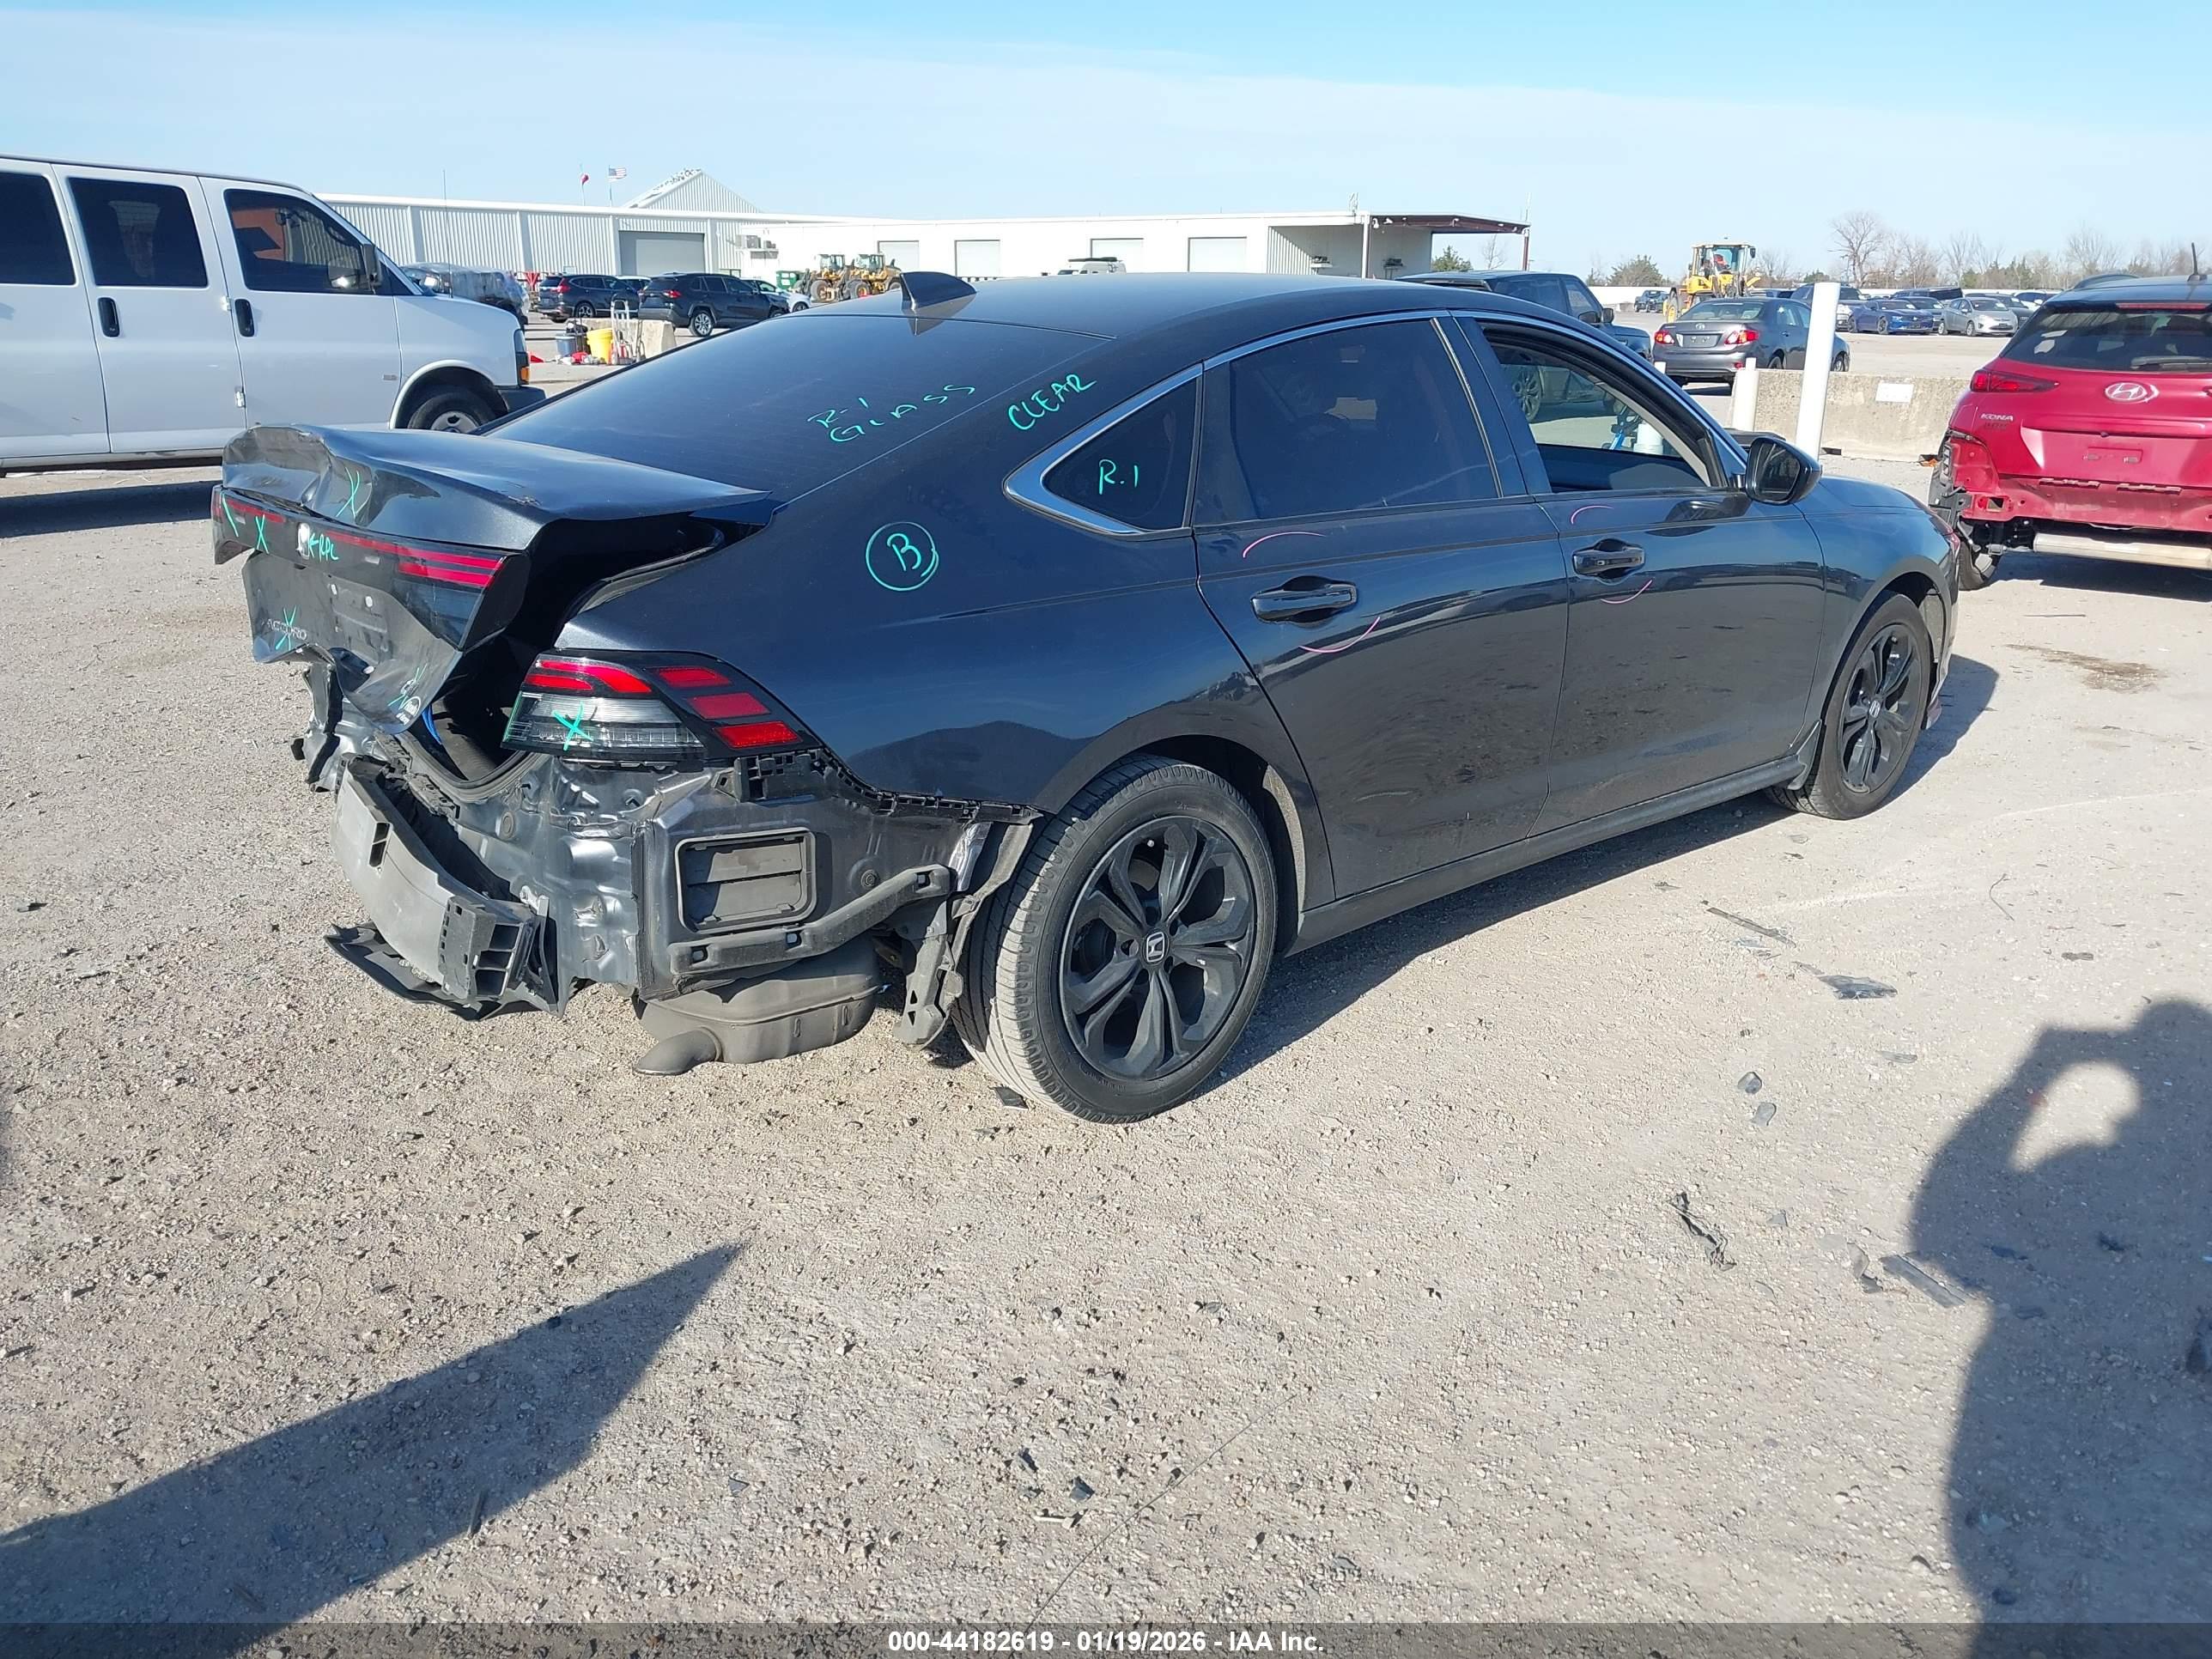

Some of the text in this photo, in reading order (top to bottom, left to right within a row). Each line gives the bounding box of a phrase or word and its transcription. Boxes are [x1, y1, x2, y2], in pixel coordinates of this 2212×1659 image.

[830, 384, 975, 442] GLASS
[1008, 373, 1097, 430] CLEAR
[1980, 412, 2014, 422] KONA
[886, 532, 922, 572] B
[265, 618, 307, 641] ACCORD
